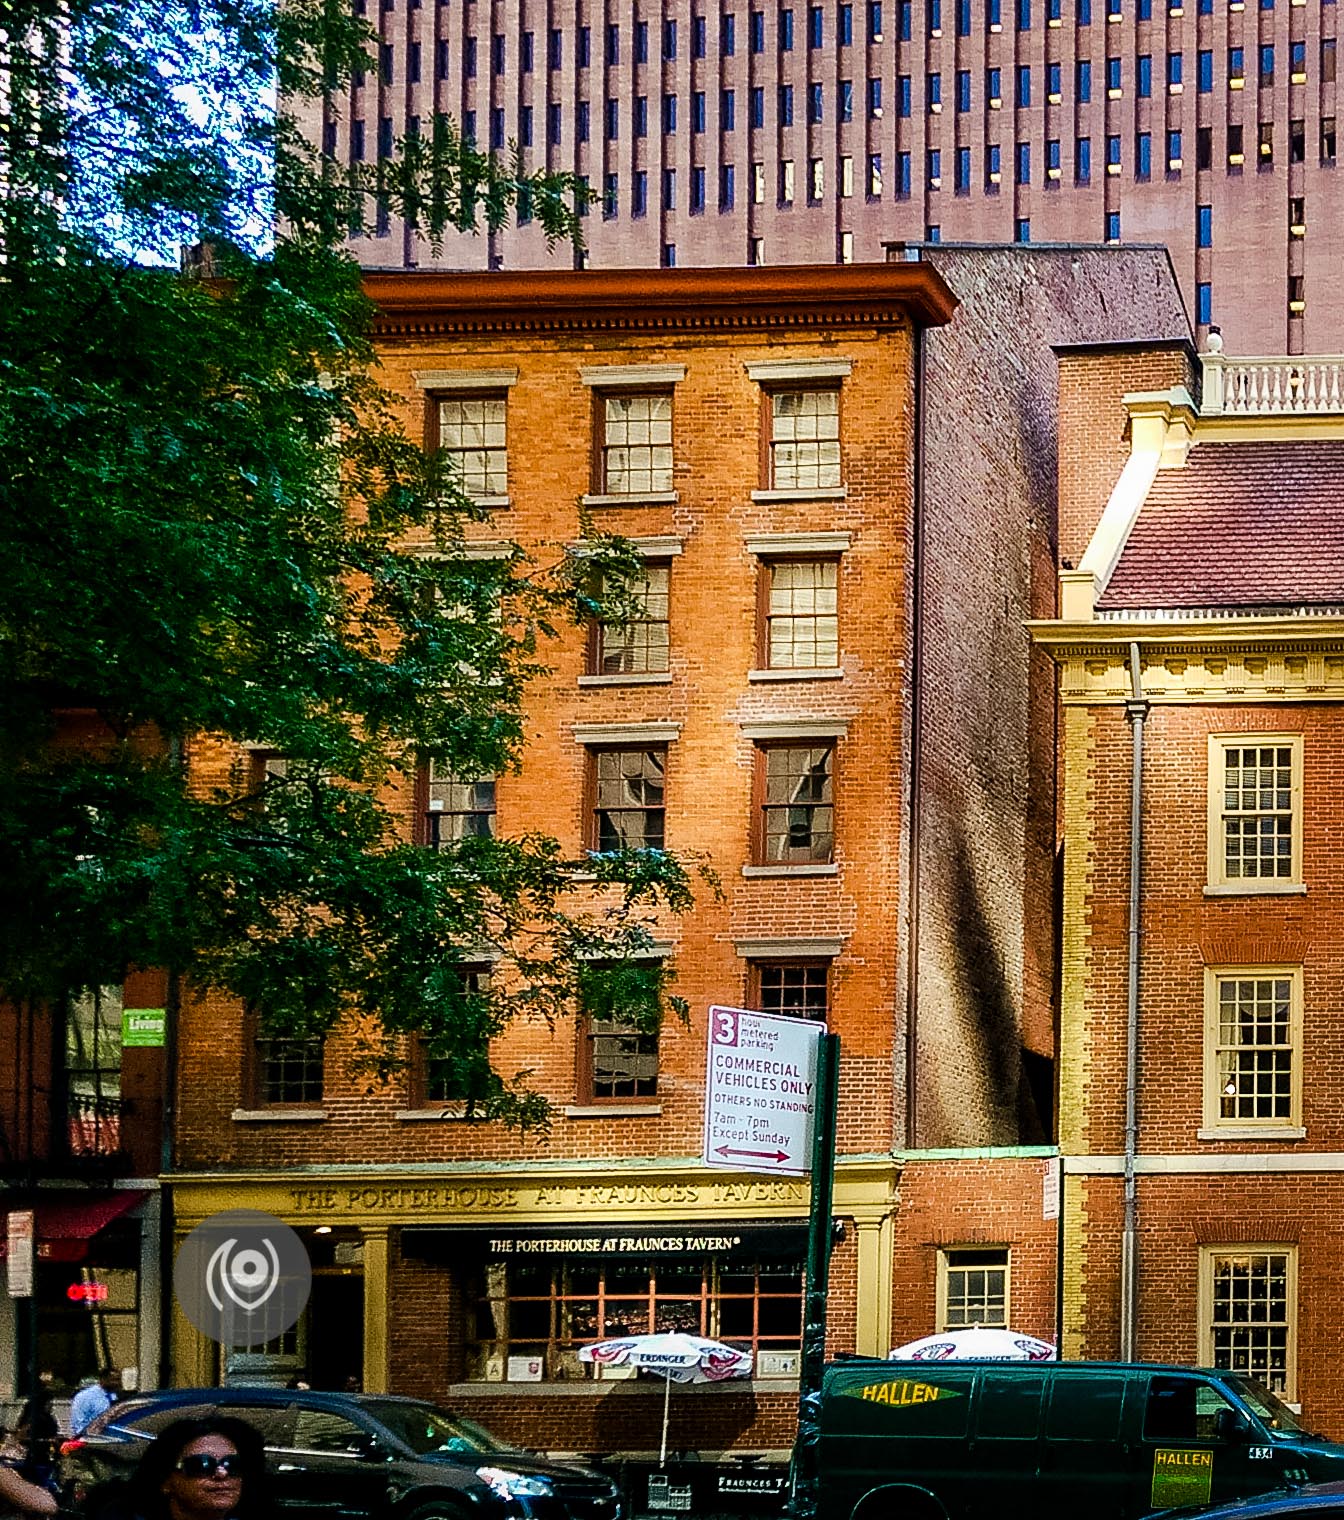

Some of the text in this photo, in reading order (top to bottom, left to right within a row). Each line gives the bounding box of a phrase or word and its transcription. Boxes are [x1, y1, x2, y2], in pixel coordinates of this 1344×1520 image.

[715, 1012, 735, 1044] 3
[741, 1016, 761, 1028] hour
[741, 1029, 779, 1041] metered
[741, 1038, 774, 1052] parking
[716, 1055, 800, 1078] COMMERCIAL
[715, 1071, 813, 1096] VEHICLES ONLY
[714, 1092, 814, 1115] OTHERS NO STANDING
[714, 1111, 736, 1125] 7am
[746, 1115, 770, 1129] 7pm
[713, 1125, 791, 1147] Except Sunday
[291, 1189, 336, 1210] THE
[346, 1187, 519, 1210] PORTERHOUSE
[534, 1185, 566, 1205] AT
[576, 1184, 699, 1206] FRAUNCES
[489, 1239, 513, 1252] THE
[515, 1238, 601, 1252] PORTERHOUSE
[602, 1238, 618, 1251] AT
[618, 1237, 684, 1251] FRAUNCES
[639, 1353, 686, 1364] ERDINGER
[862, 1382, 939, 1405] HALLEN
[1156, 1452, 1211, 1466] HALLEN
[718, 1476, 771, 1488] FRAUNCES
